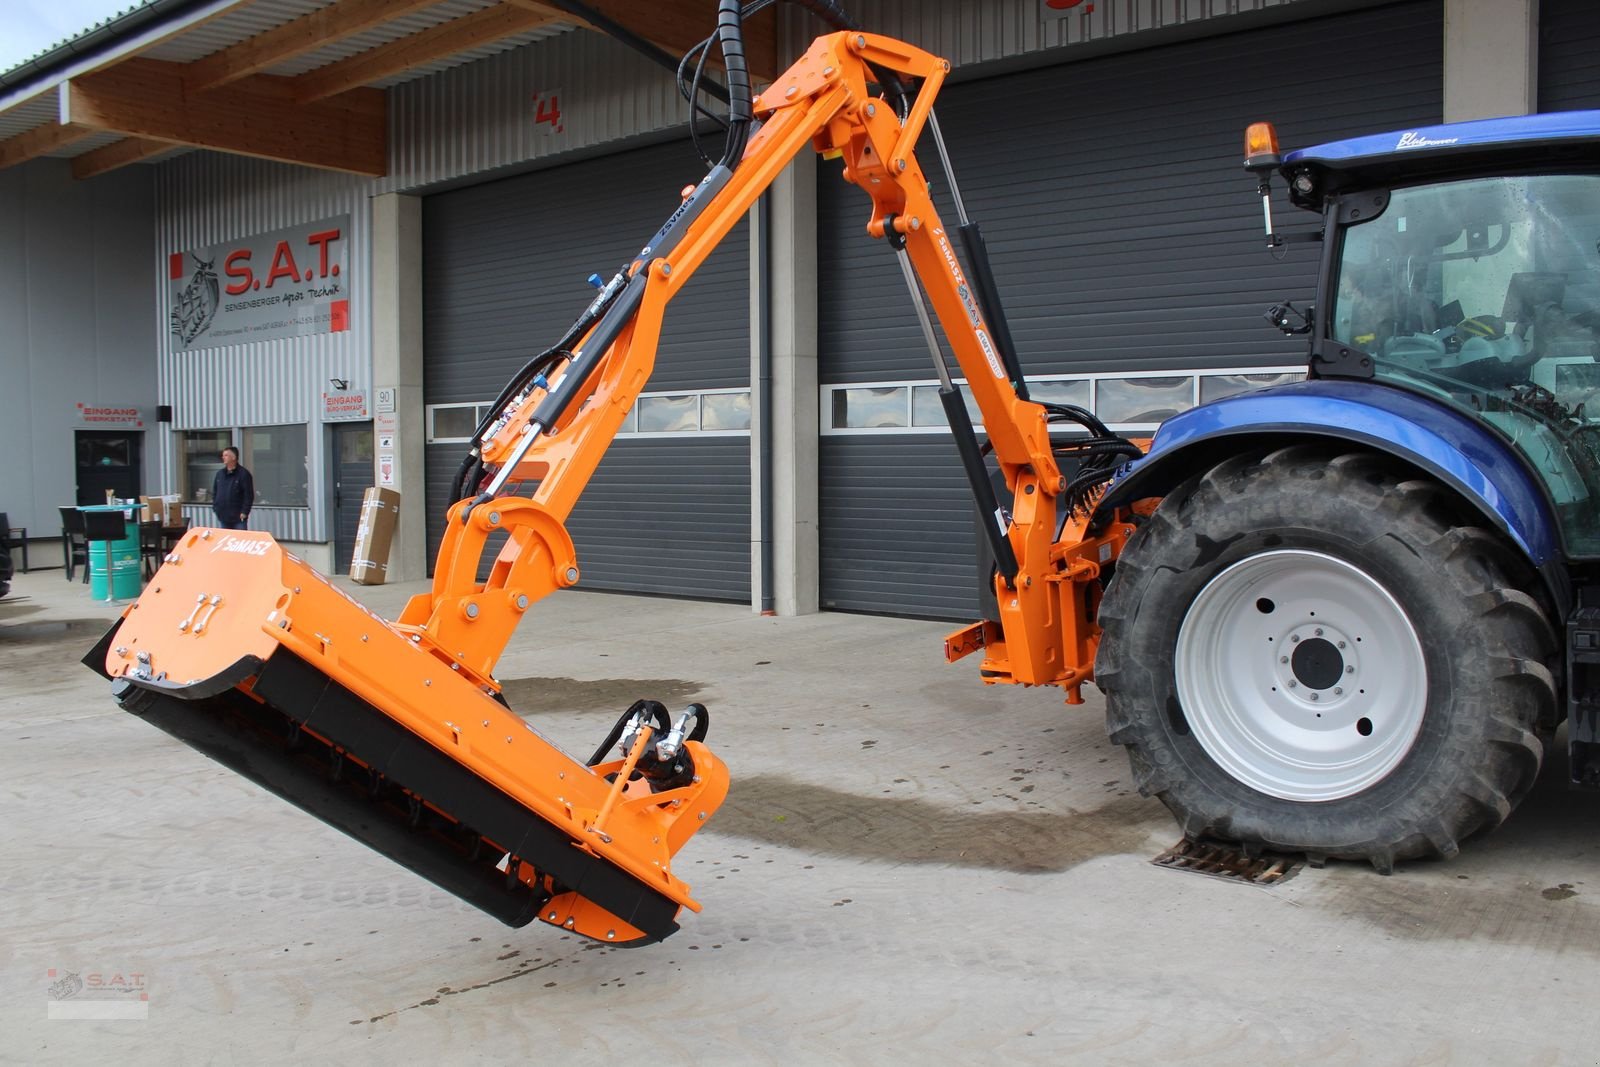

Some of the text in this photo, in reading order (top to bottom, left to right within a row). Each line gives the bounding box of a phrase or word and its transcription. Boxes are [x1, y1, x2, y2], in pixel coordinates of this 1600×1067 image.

[536, 96, 560, 126] 4
[660, 195, 695, 236] SaMASZ
[224, 228, 340, 295] S.A.T.
[939, 237, 962, 284] SaMASZ
[225, 297, 280, 312] SENSENBERGER
[307, 284, 339, 299] Technik
[327, 395, 362, 405] EINGANG
[380, 392, 390, 402] 90
[222, 537, 272, 555] SaMASZ
